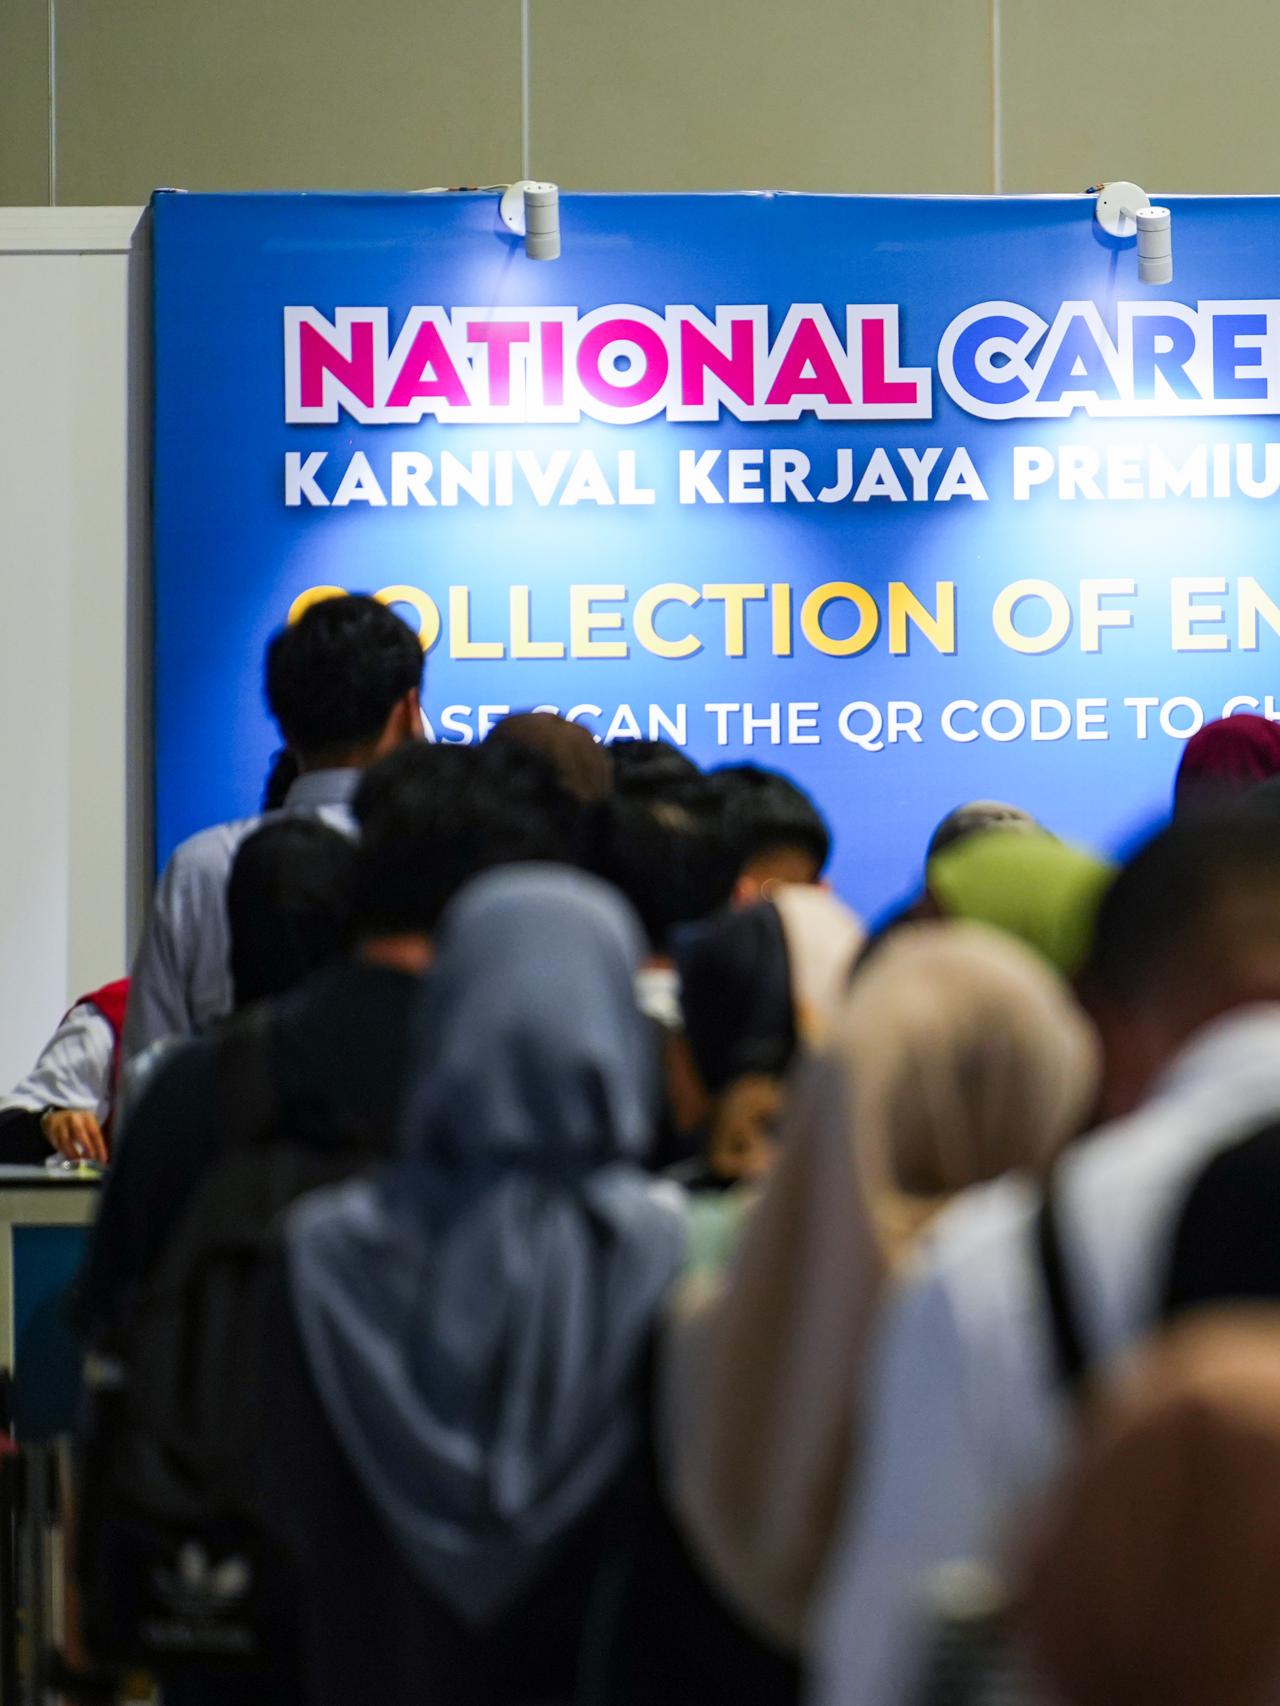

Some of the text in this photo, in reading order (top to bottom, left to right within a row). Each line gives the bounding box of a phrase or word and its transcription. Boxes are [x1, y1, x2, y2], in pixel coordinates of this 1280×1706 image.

[284, 304, 932, 425] NATIONAL
[284, 450, 655, 506] KARNIVAL
[679, 447, 988, 503] KERJAYA
[288, 581, 955, 660] OLLECTION
[992, 577, 1135, 654] OF
[704, 702, 821, 745] THE
[838, 700, 924, 752] QR
[941, 698, 1109, 743] CODE
[1124, 696, 1204, 739] TO
